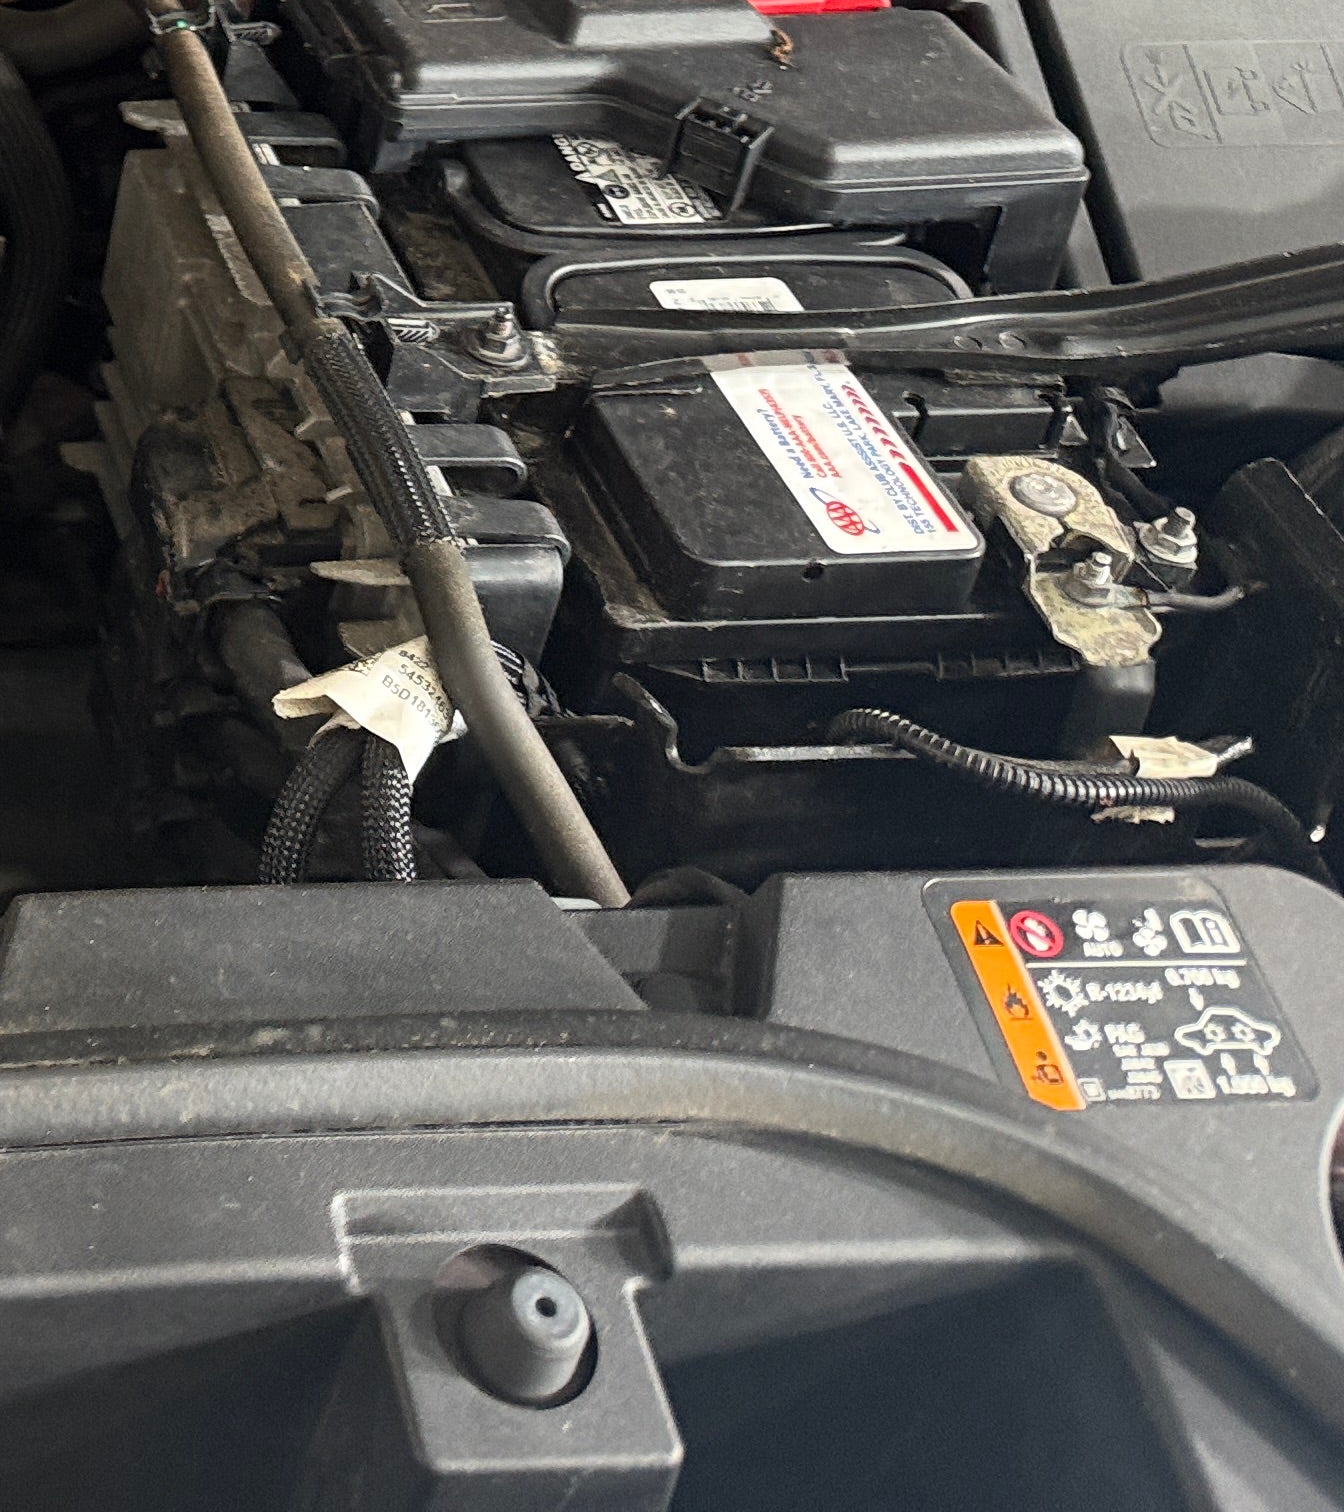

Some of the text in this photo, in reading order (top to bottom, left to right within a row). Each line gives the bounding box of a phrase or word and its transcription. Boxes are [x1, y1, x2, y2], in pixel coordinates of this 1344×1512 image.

[755, 409, 791, 445] Battery?
[840, 410, 861, 429] LAKE
[790, 456, 813, 477] Need
[874, 474, 897, 495] CLUB
[877, 460, 924, 515] TECHNOLOGY
[892, 499, 907, 509] BY
